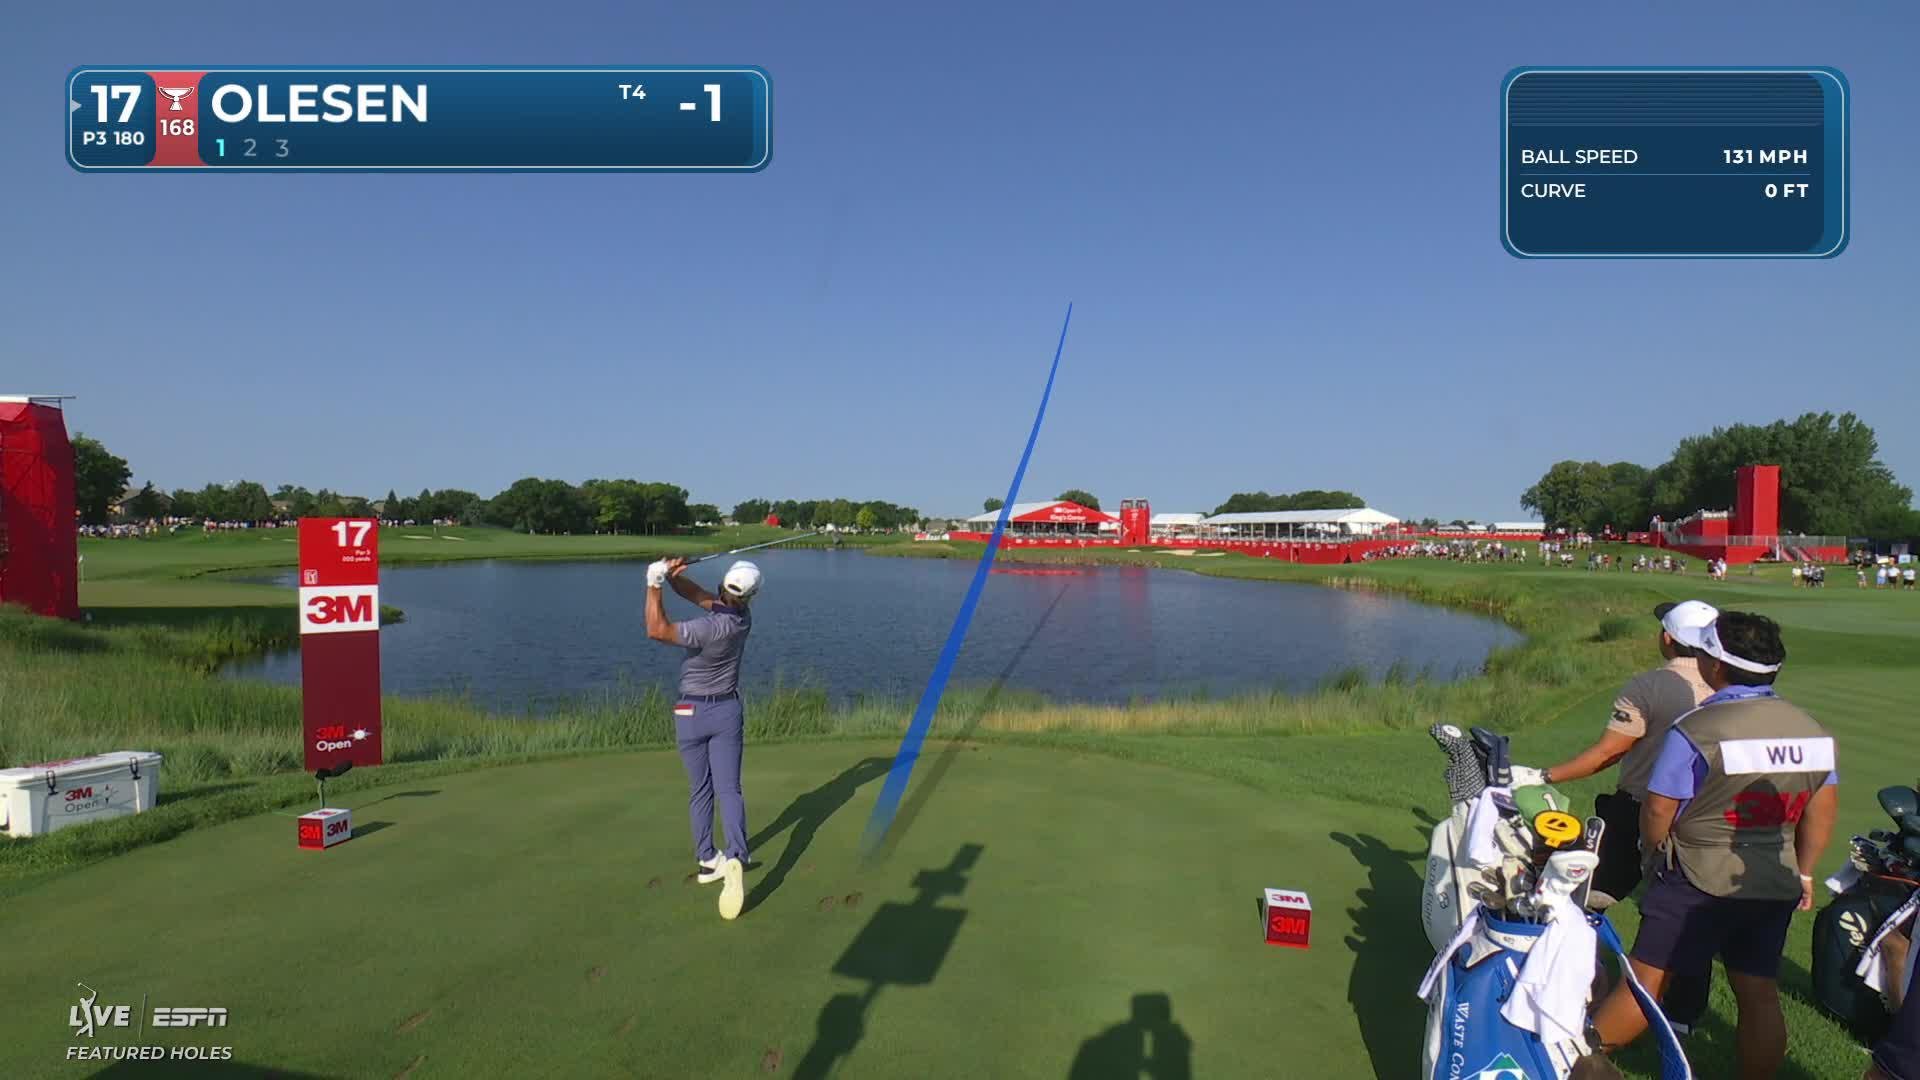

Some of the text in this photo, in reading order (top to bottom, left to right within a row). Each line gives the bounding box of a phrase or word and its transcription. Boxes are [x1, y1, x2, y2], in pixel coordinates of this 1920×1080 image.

[331, 521, 372, 547] 17
[306, 595, 372, 625] 3M
[316, 726, 344, 740] 3M
[316, 740, 352, 753] Open
[1766, 745, 1804, 765] WU
[65, 787, 92, 802] 3M
[66, 801, 97, 812] Open
[301, 824, 321, 840] 3M
[327, 819, 348, 837] 3M
[1271, 893, 1305, 904] 3M
[1271, 915, 1306, 935] 3M
[1454, 1001, 1470, 1048] WASTE
